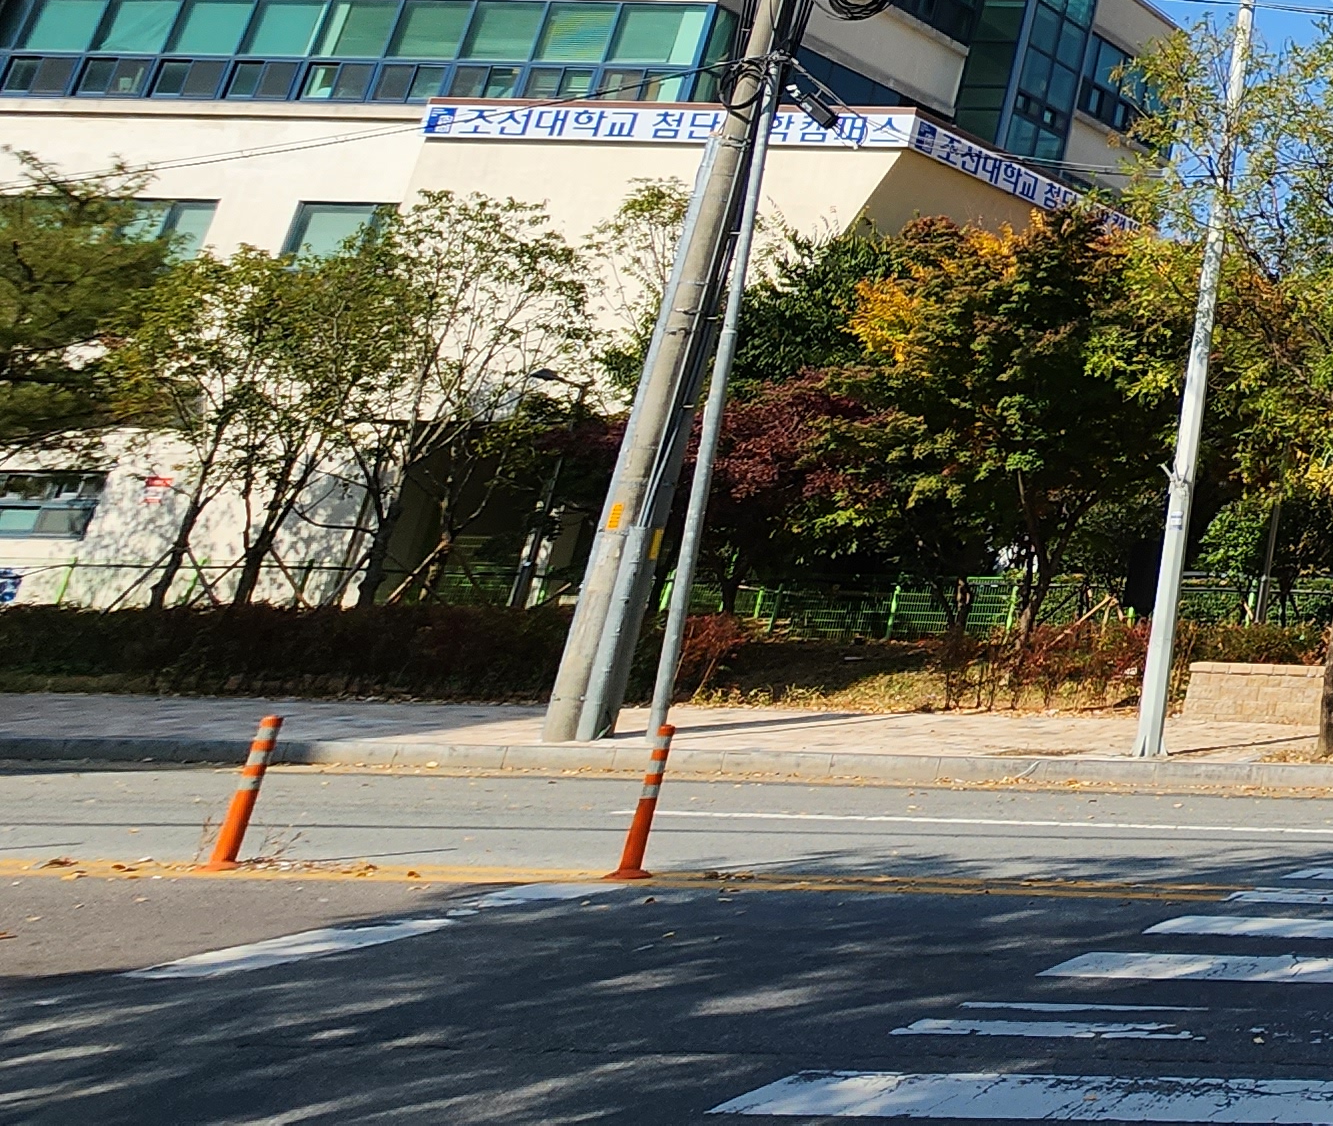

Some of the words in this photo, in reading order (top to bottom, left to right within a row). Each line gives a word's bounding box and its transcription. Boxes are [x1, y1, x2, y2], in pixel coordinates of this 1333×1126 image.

[458, 108, 639, 138] 조선대학교
[652, 111, 904, 144] 첨단학캠퍼스
[937, 133, 1040, 201] 조선대학교
